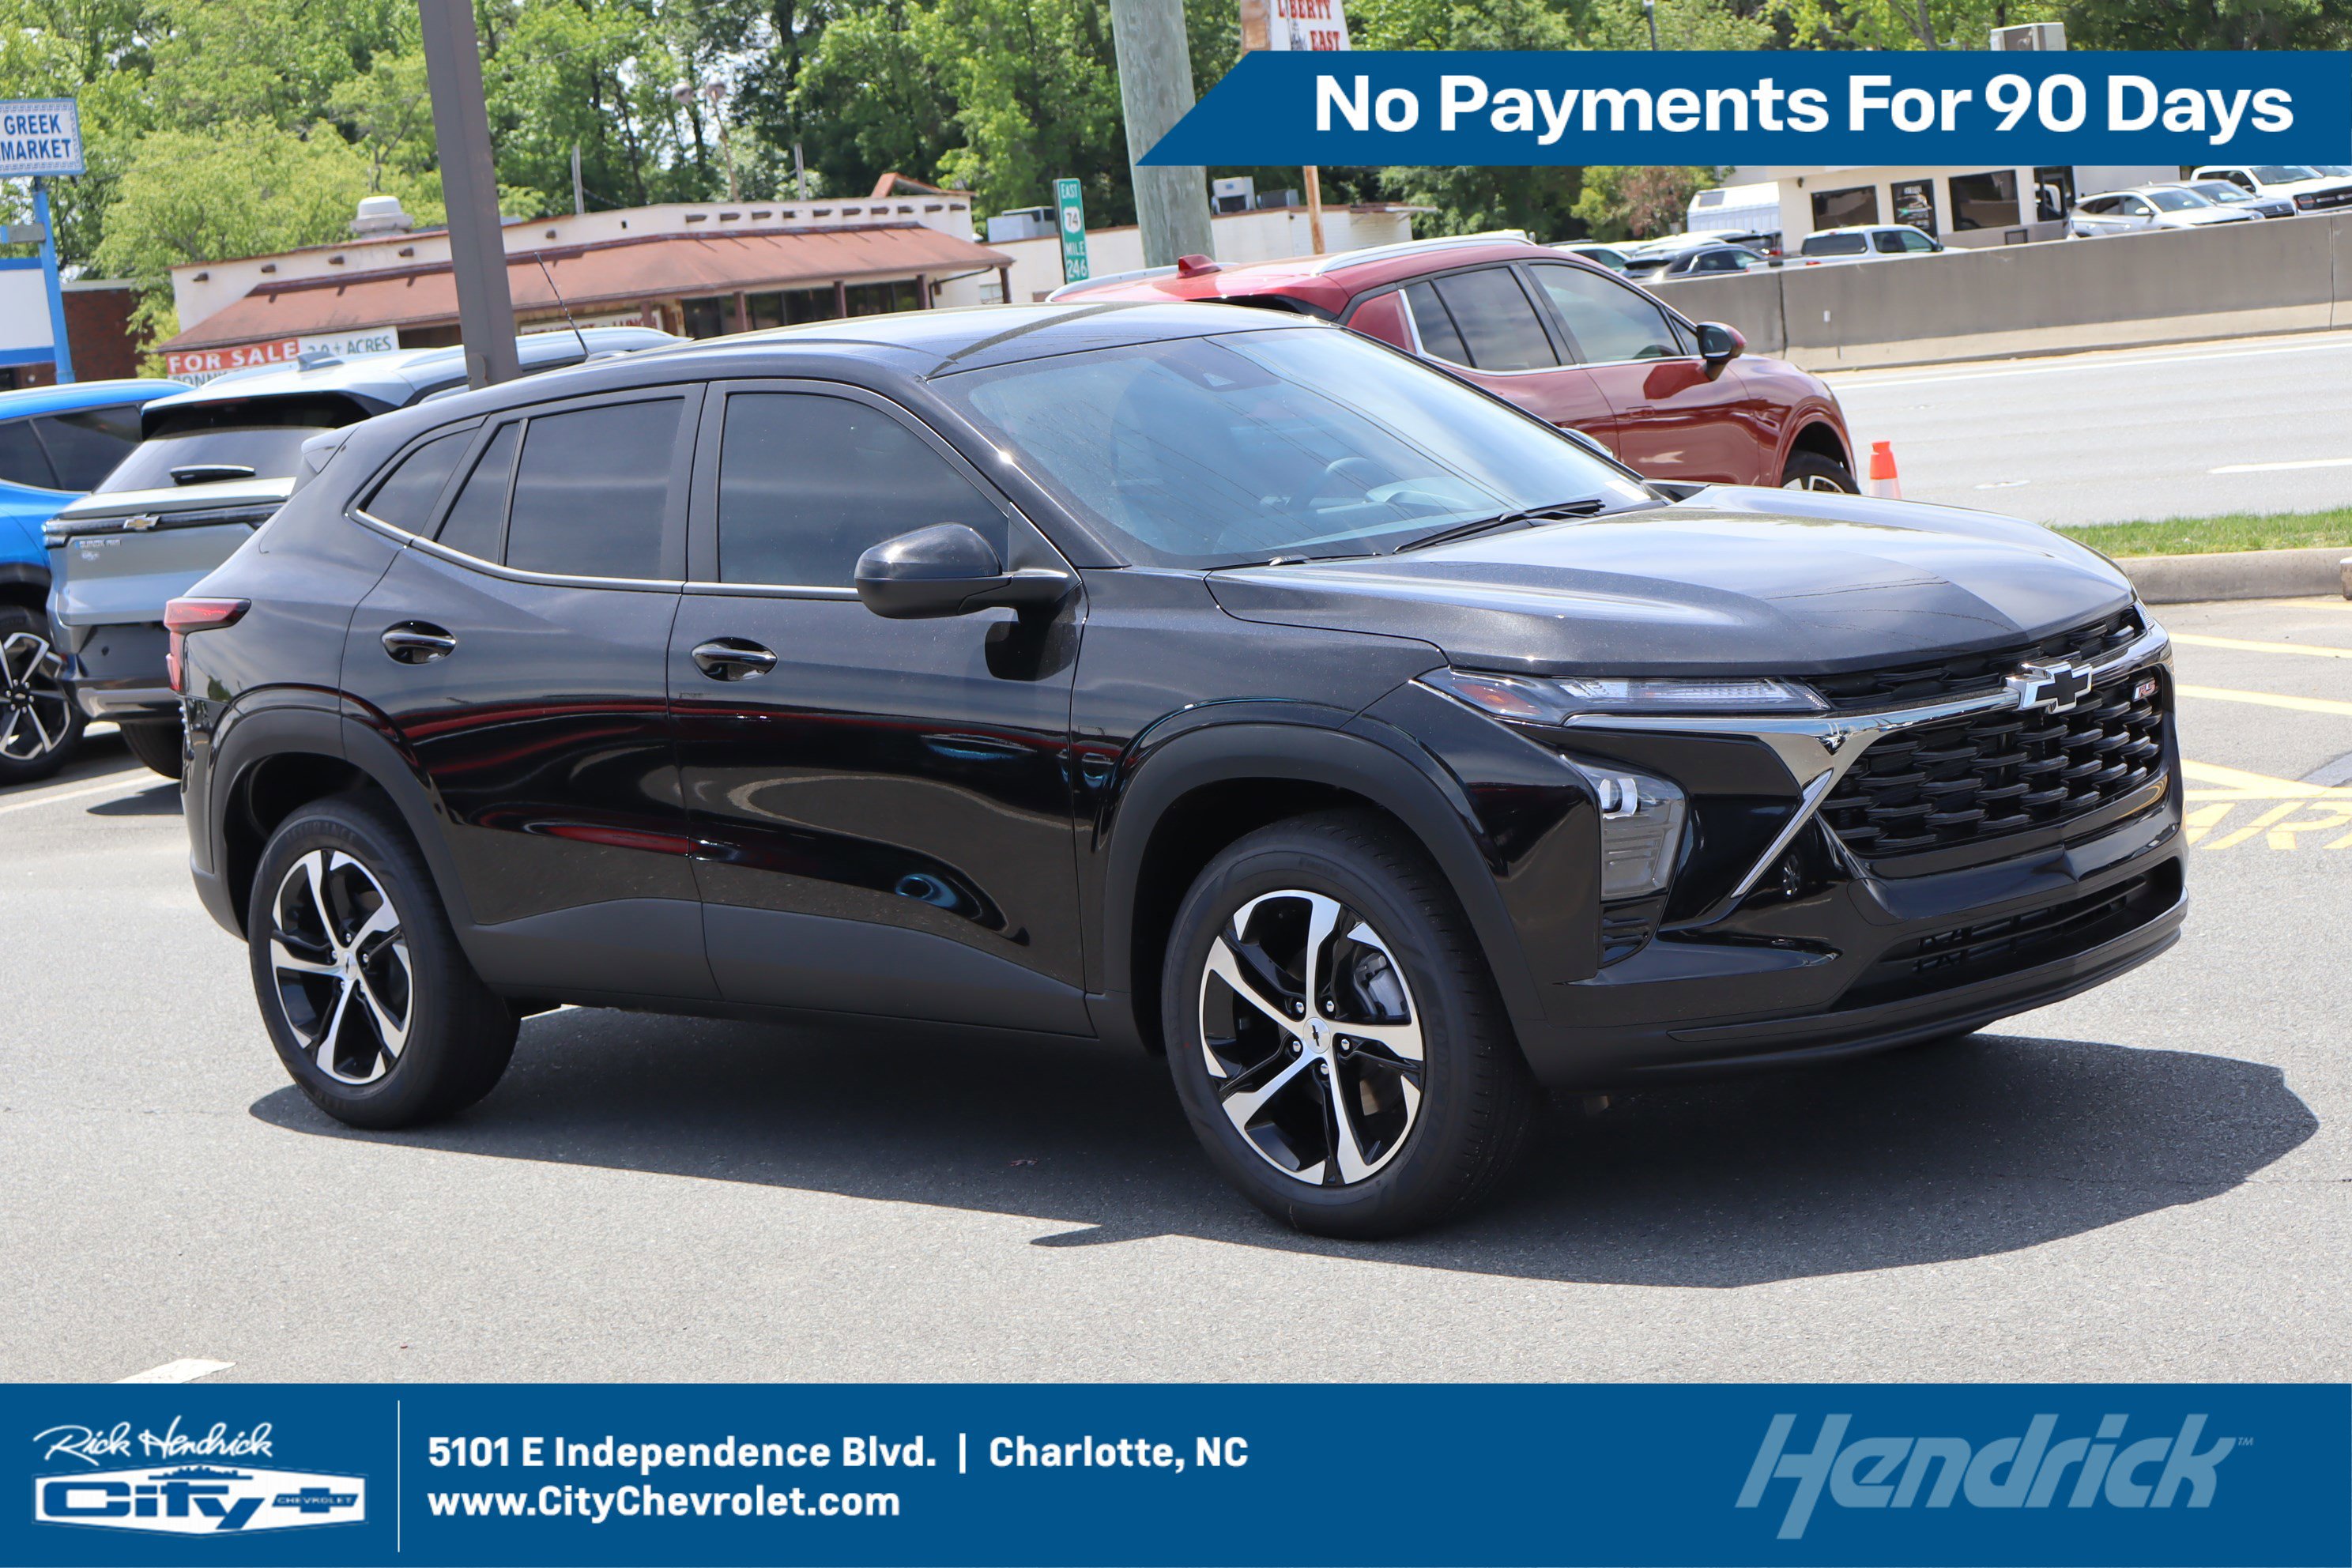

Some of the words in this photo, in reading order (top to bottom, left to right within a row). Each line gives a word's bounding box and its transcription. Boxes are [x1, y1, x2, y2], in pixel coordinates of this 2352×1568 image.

[1278, 0, 1332, 19] LBERTY
[1310, 31, 1340, 51] EAST
[4, 114, 62, 135] GREEK
[1, 138, 71, 161] MARKET
[1061, 183, 1078, 199] EAST
[1066, 212, 1079, 228] 74
[1065, 240, 1086, 256] MILE
[1066, 258, 1088, 279] 246
[347, 335, 392, 354] ACRES
[168, 352, 222, 374] FOR
[231, 341, 297, 367] SALE
[2139, 679, 2156, 697] RS
